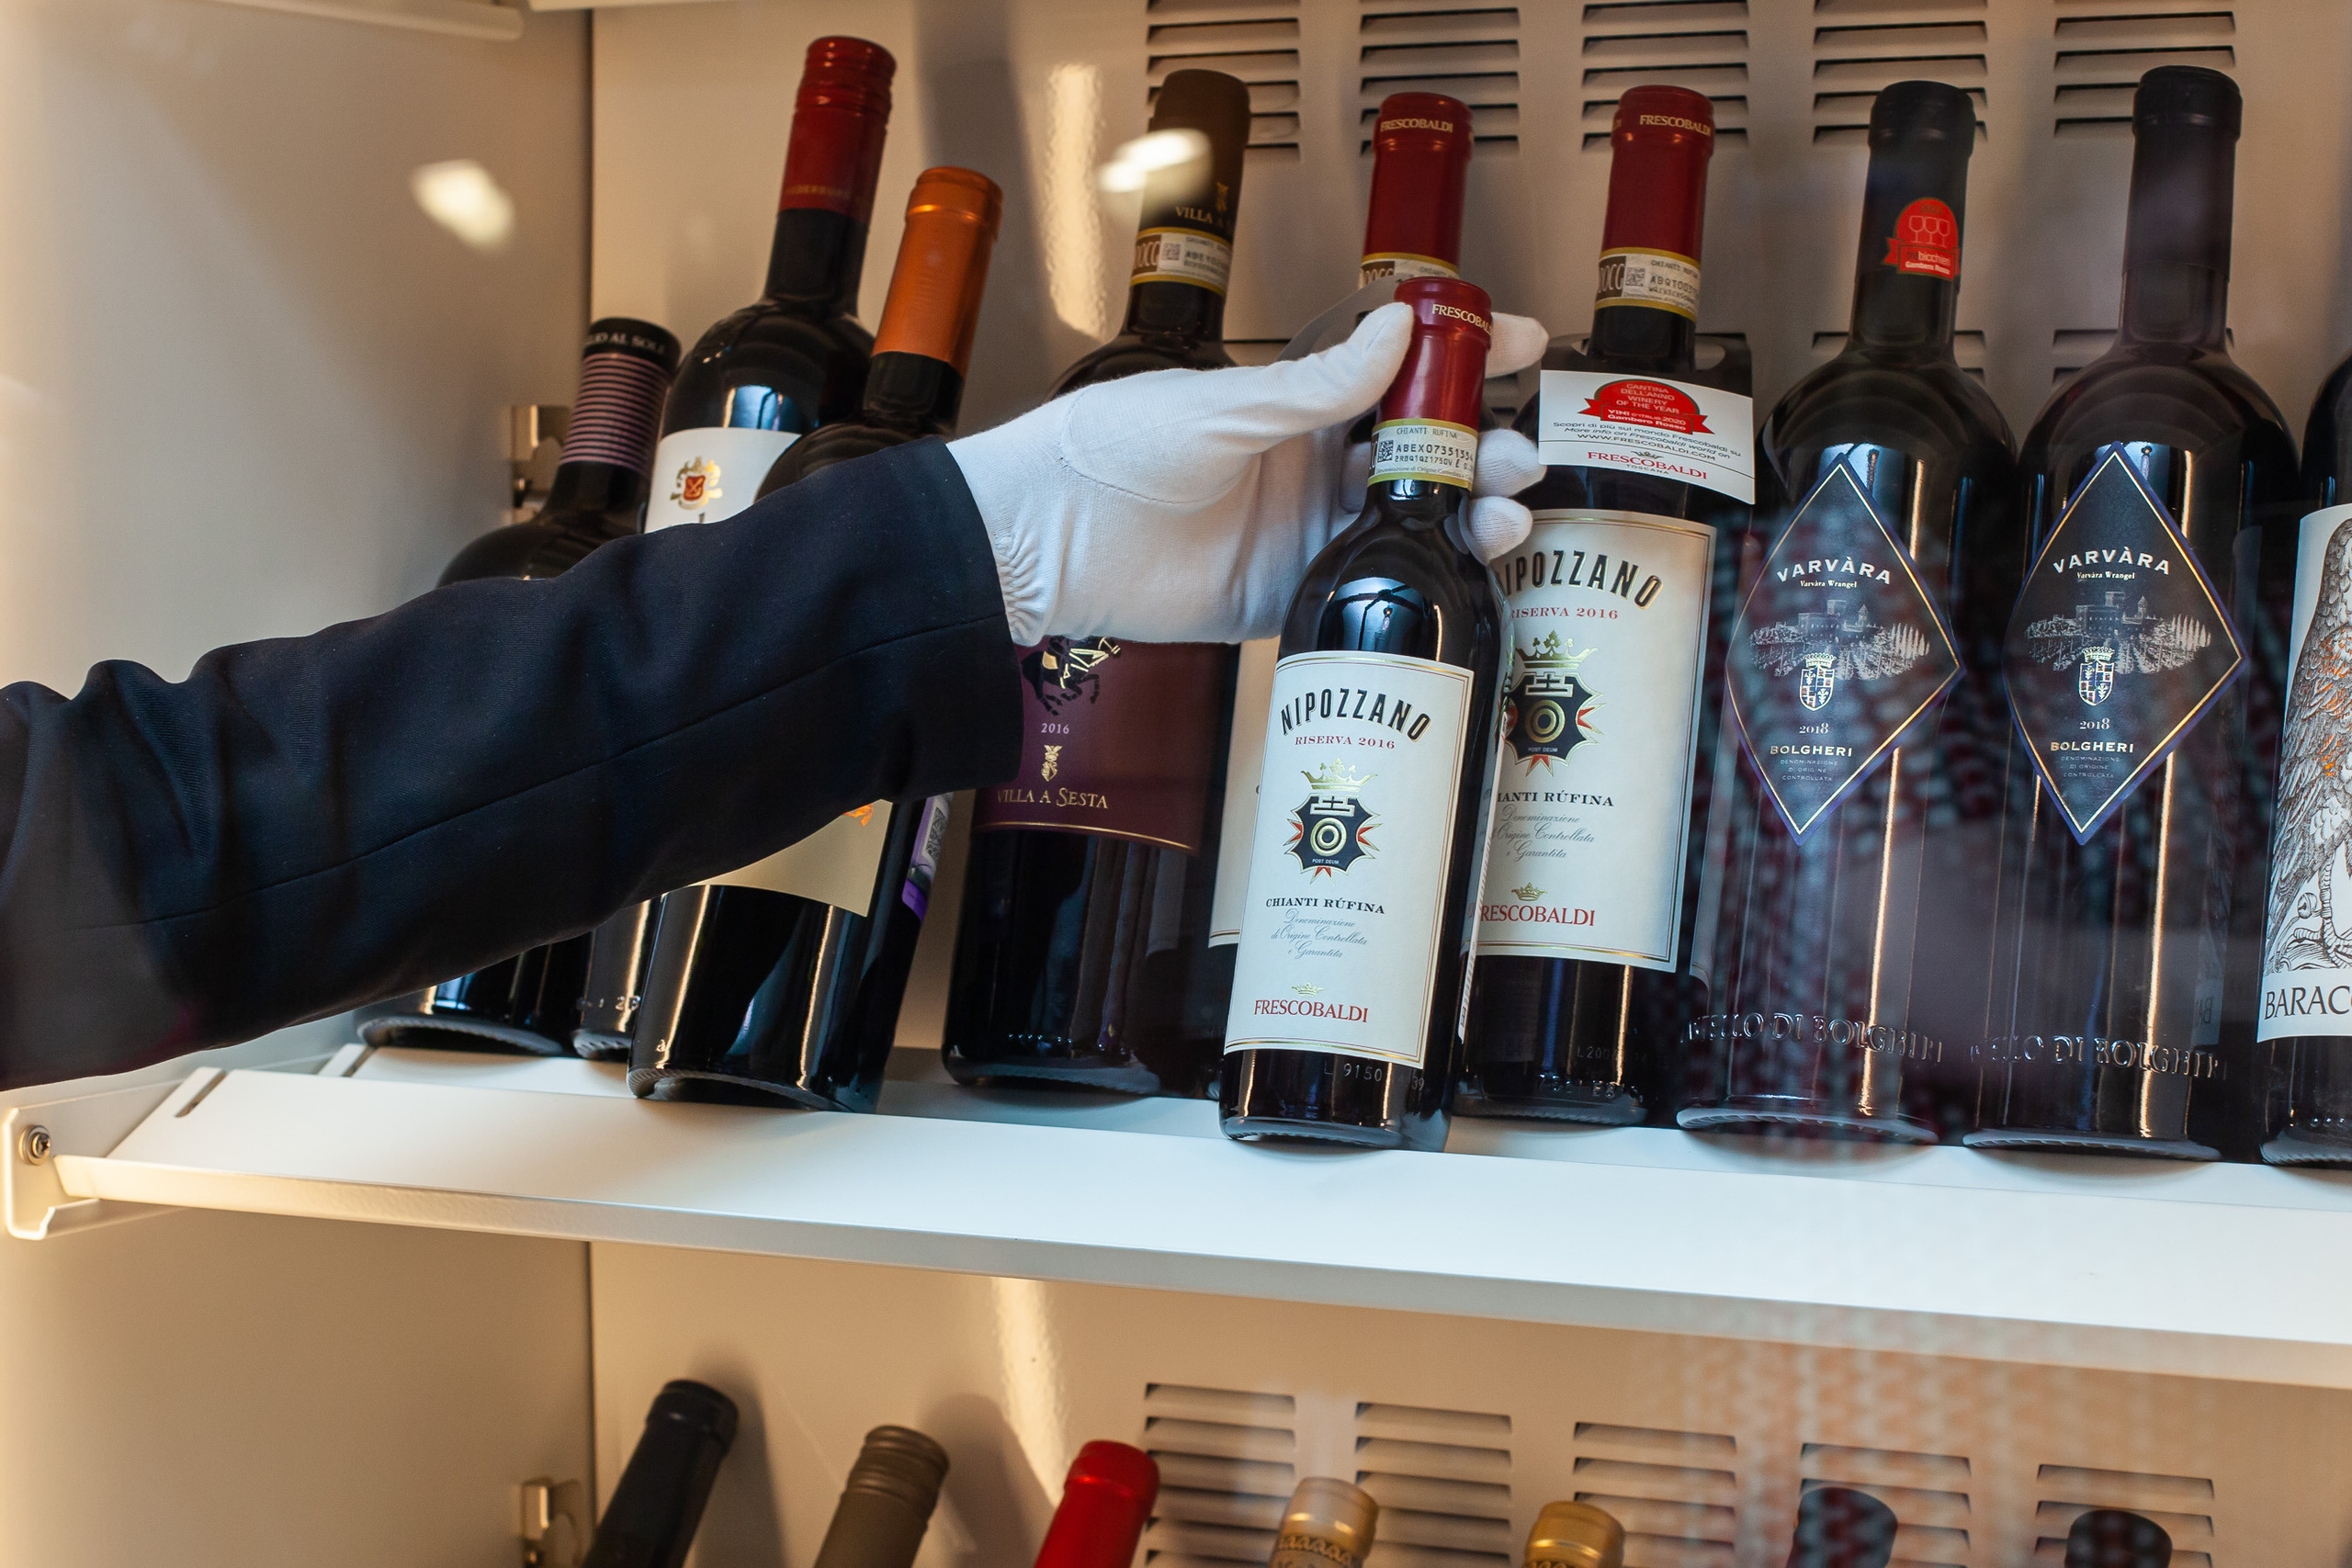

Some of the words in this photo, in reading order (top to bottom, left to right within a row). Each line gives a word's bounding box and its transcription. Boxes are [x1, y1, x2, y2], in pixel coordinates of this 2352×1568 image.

[1380, 118, 1453, 132] FRESCOBALDI
[1640, 115, 1711, 136] FRESCOBALDI
[1176, 206, 1213, 223] VILLA
[1621, 389, 1675, 400] DELL'ANNO
[1626, 383, 1668, 393] CANTINA
[1627, 395, 1668, 405] WINERY
[1654, 405, 1679, 413] YEAR
[1607, 414, 1653, 424] Gambero
[1656, 421, 1686, 431] Rosso
[1662, 416, 1686, 425] 2020
[1432, 428, 1457, 439] RUFINA
[1634, 428, 1669, 437] mondo
[1672, 434, 1728, 452] Frescobaldi
[1577, 434, 1715, 460] WWW.FRESCOBALDI.COM
[1630, 433, 1686, 447] Frescobaldi
[1689, 444, 1716, 455] world
[1588, 451, 1707, 479] FRESCOBALDI
[1626, 464, 1668, 474] TOSCANA
[2052, 546, 2169, 575] VARVÀRA
[1776, 556, 1891, 585] VARVÀRA
[2105, 570, 2135, 581] Wrangel
[1827, 579, 1857, 589] Wrangel
[1576, 608, 1618, 620] 2016
[1281, 688, 1432, 743] NIPOZZANO
[2079, 717, 2110, 730] 2018
[1041, 723, 1069, 734] 2016
[1799, 722, 1829, 734] 2018
[1295, 735, 1351, 746] RISERVA
[1358, 737, 1395, 750] 2016
[1770, 745, 1853, 757] BOLGHERI
[2050, 741, 2134, 753] BOLGHERI
[998, 789, 1035, 803] VILLA
[1039, 790, 1051, 803] A
[1497, 793, 1539, 803] IANTI
[1544, 790, 1613, 807] RÚFINA
[1501, 804, 1580, 823] Denominazione
[1498, 821, 1530, 842] Origine
[1534, 822, 1595, 842] Controllata
[1513, 840, 1567, 862] Garantita
[1265, 897, 1318, 908] CHIANTI
[1323, 897, 1385, 915] RÚFINA
[1283, 908, 1355, 928] Denominazione
[1480, 905, 1595, 926] RESCOBALDI
[1271, 928, 1280, 940] di
[1280, 924, 1311, 943] Origine
[1314, 925, 1368, 945] Controllata
[1295, 941, 1343, 960] Garantita
[1253, 999, 1369, 1023] FRESCOBALDI
[2264, 986, 2352, 1021] BARAC
[1343, 1063, 1383, 1082] 9150
